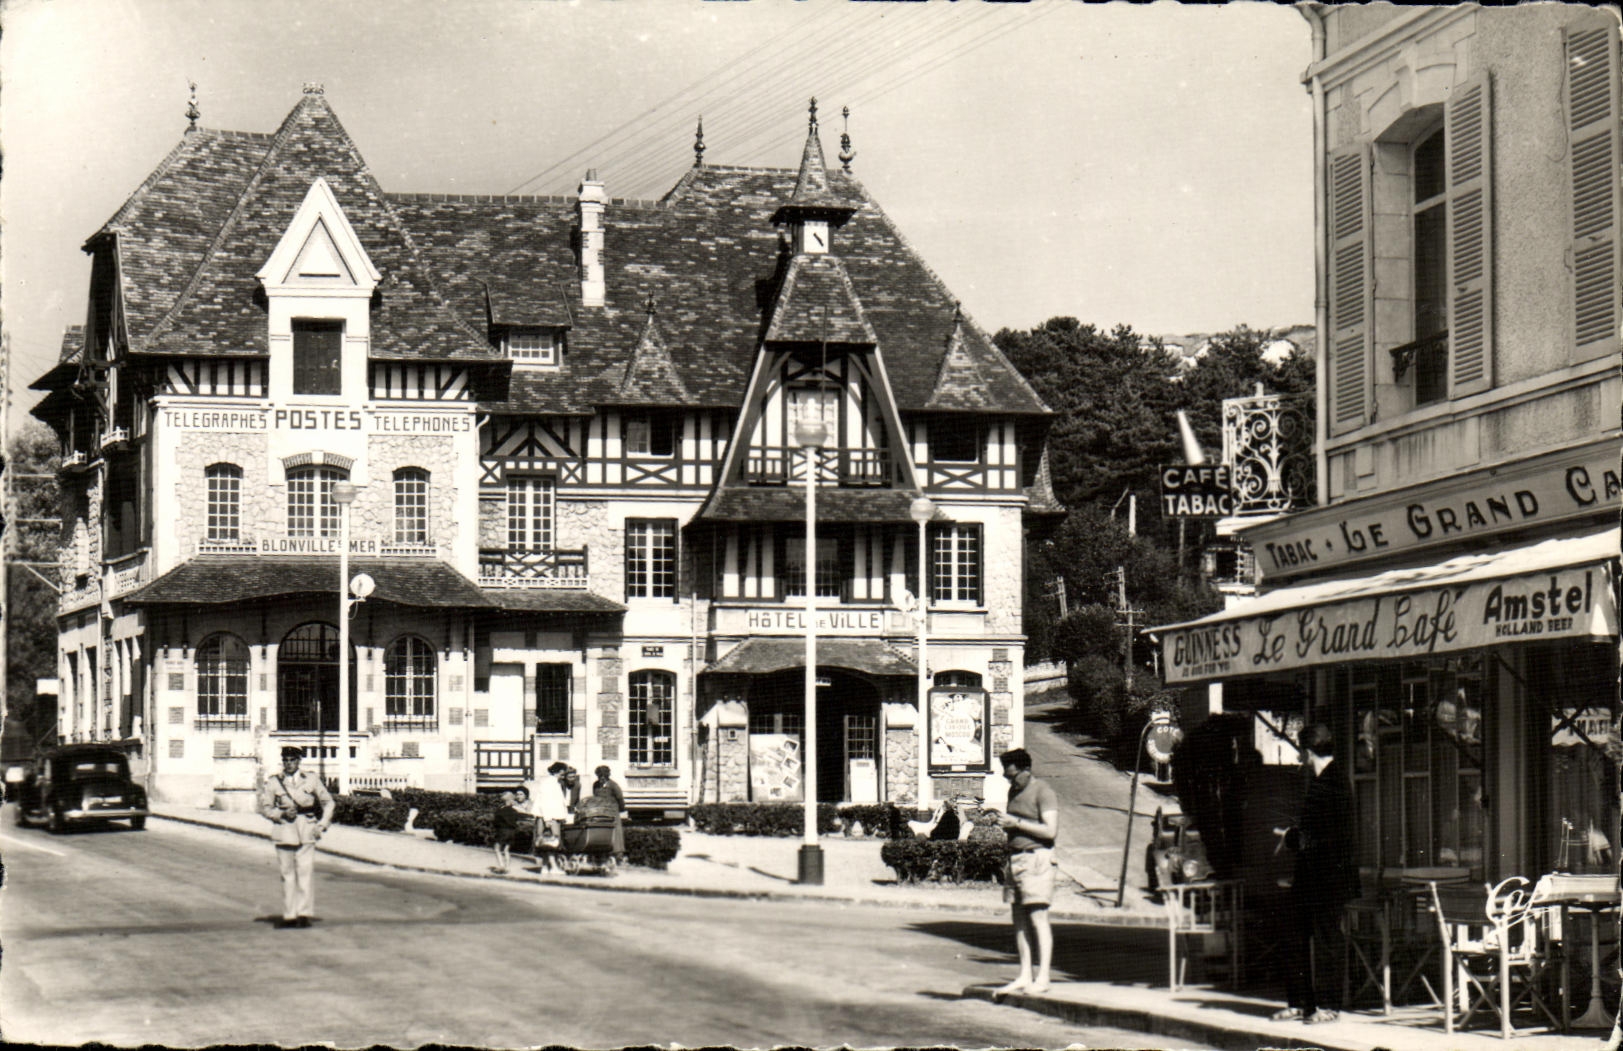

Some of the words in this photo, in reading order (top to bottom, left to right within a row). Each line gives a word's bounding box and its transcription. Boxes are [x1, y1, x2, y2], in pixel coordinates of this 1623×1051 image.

[165, 411, 267, 429] TELEGRAPHES
[275, 409, 362, 430] POSTES
[374, 415, 470, 432] TELEPHONES
[1163, 466, 1228, 490] CAFÉ
[1164, 494, 1229, 515] TABAC
[1265, 538, 1318, 569] TABAC
[1407, 490, 1539, 539] GRAND
[262, 539, 336, 553] BLONVILLE
[349, 540, 376, 553] MER
[1483, 570, 1593, 625] Amstel
[1253, 615, 1286, 665] Le
[1297, 598, 1378, 658] Grand
[1387, 589, 1464, 652] Café
